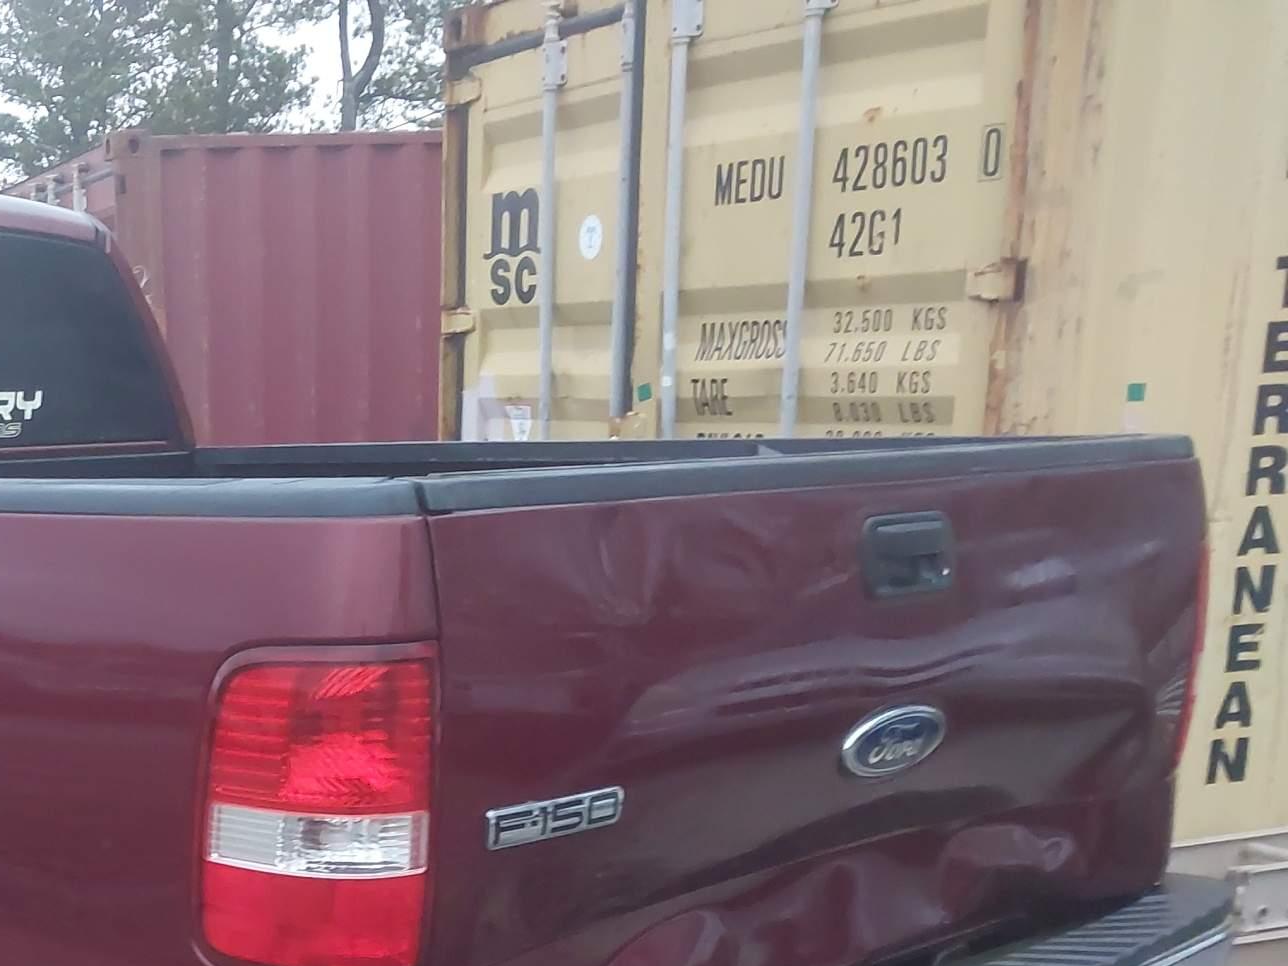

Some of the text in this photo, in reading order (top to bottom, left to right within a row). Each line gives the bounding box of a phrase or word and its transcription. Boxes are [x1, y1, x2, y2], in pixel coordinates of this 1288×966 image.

[714, 127, 1002, 207] MEDU 428603 0
[828, 207, 903, 259] 42G1
[911, 306, 948, 331] KGS
[901, 339, 941, 362] LBS
[691, 378, 733, 416] TARE
[896, 370, 932, 394] KGS
[898, 402, 936, 423] LBS
